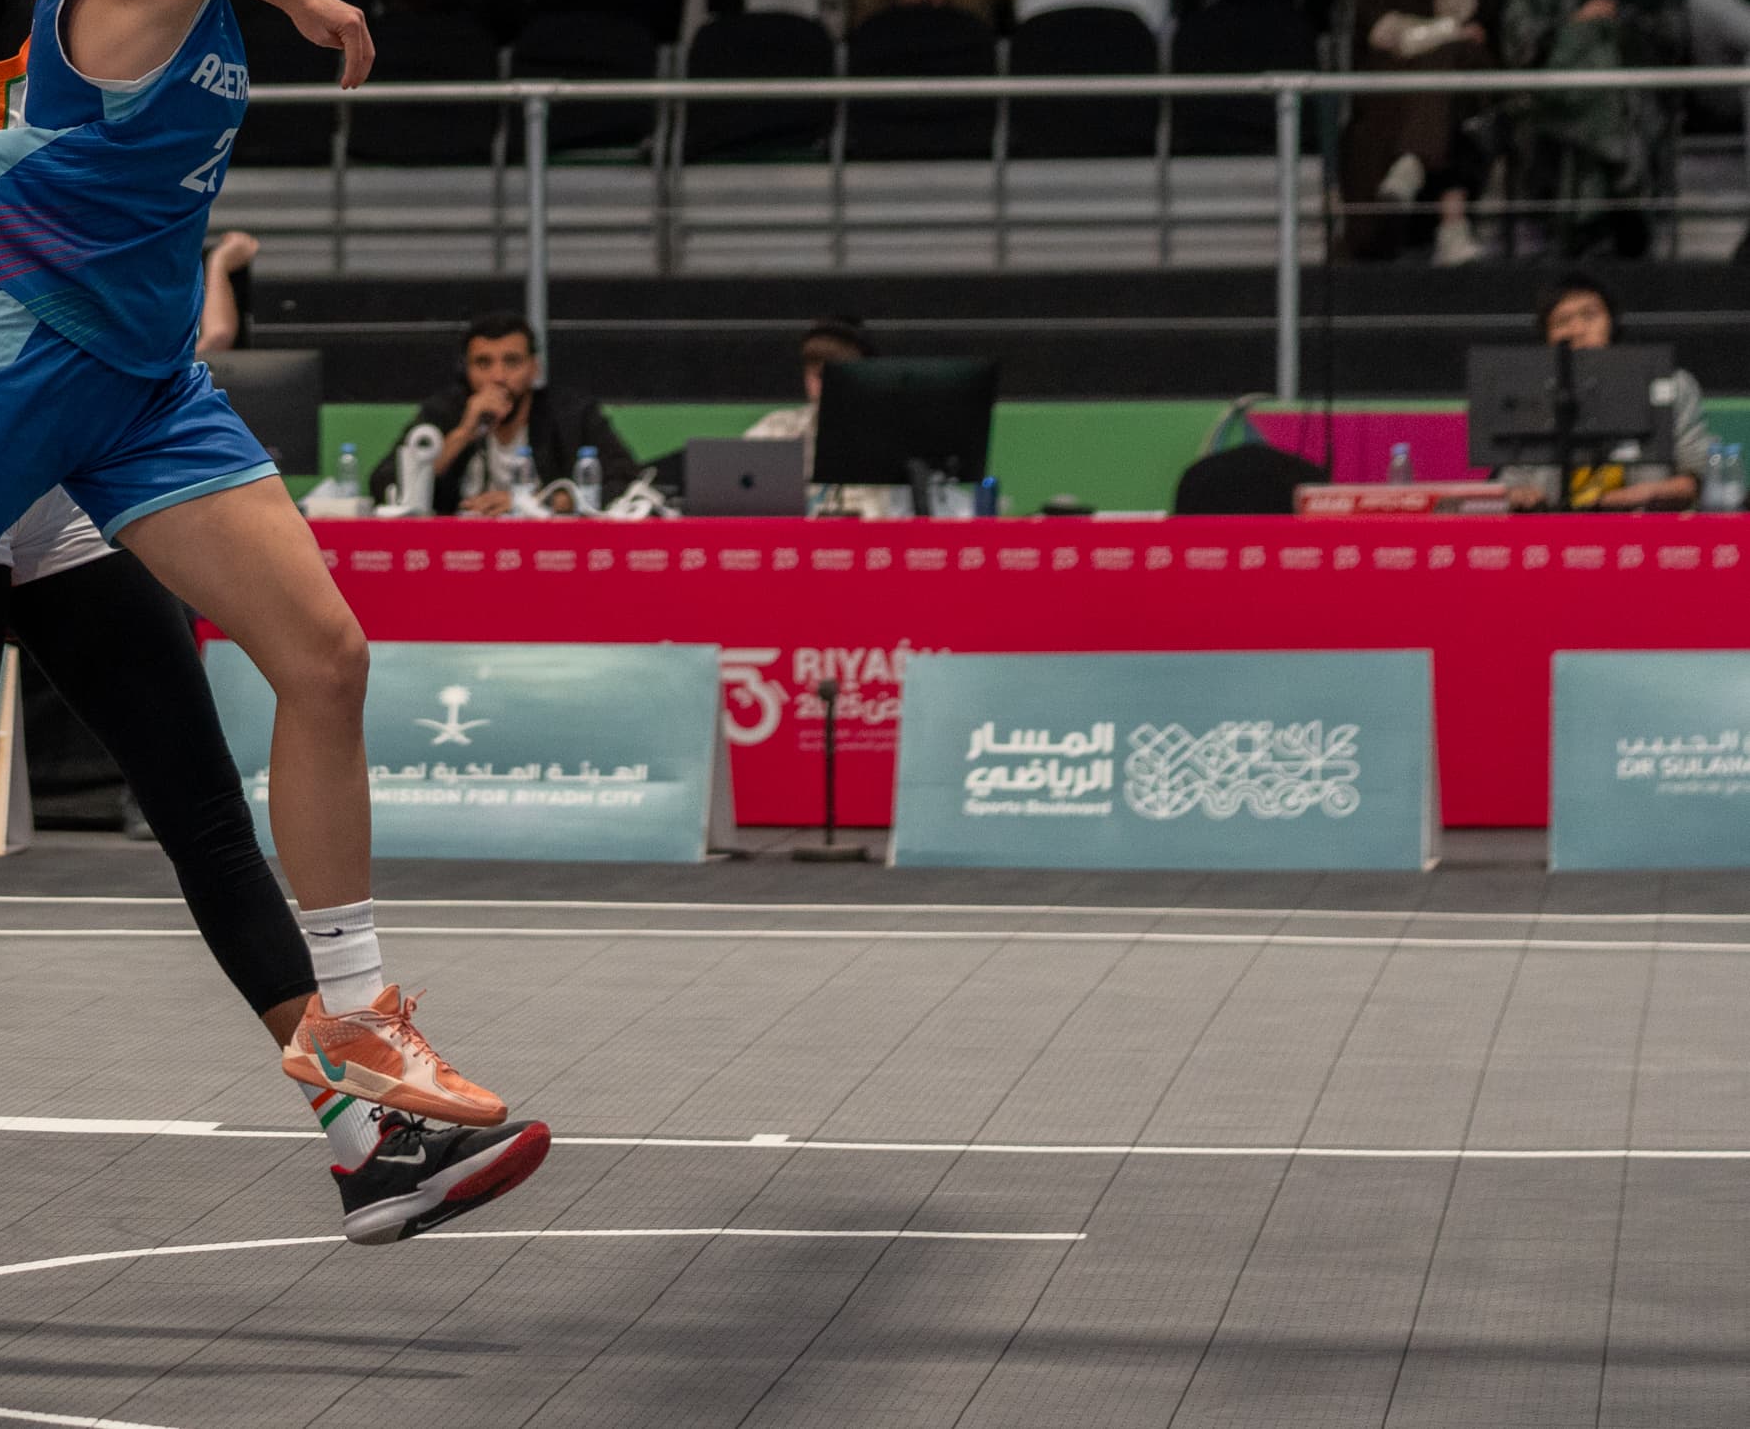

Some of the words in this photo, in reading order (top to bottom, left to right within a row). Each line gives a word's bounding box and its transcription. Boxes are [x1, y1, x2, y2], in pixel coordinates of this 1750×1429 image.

[190, 53, 249, 100] AZER
[965, 721, 1115, 760] المسار
[965, 758, 1114, 798] الرياضي
